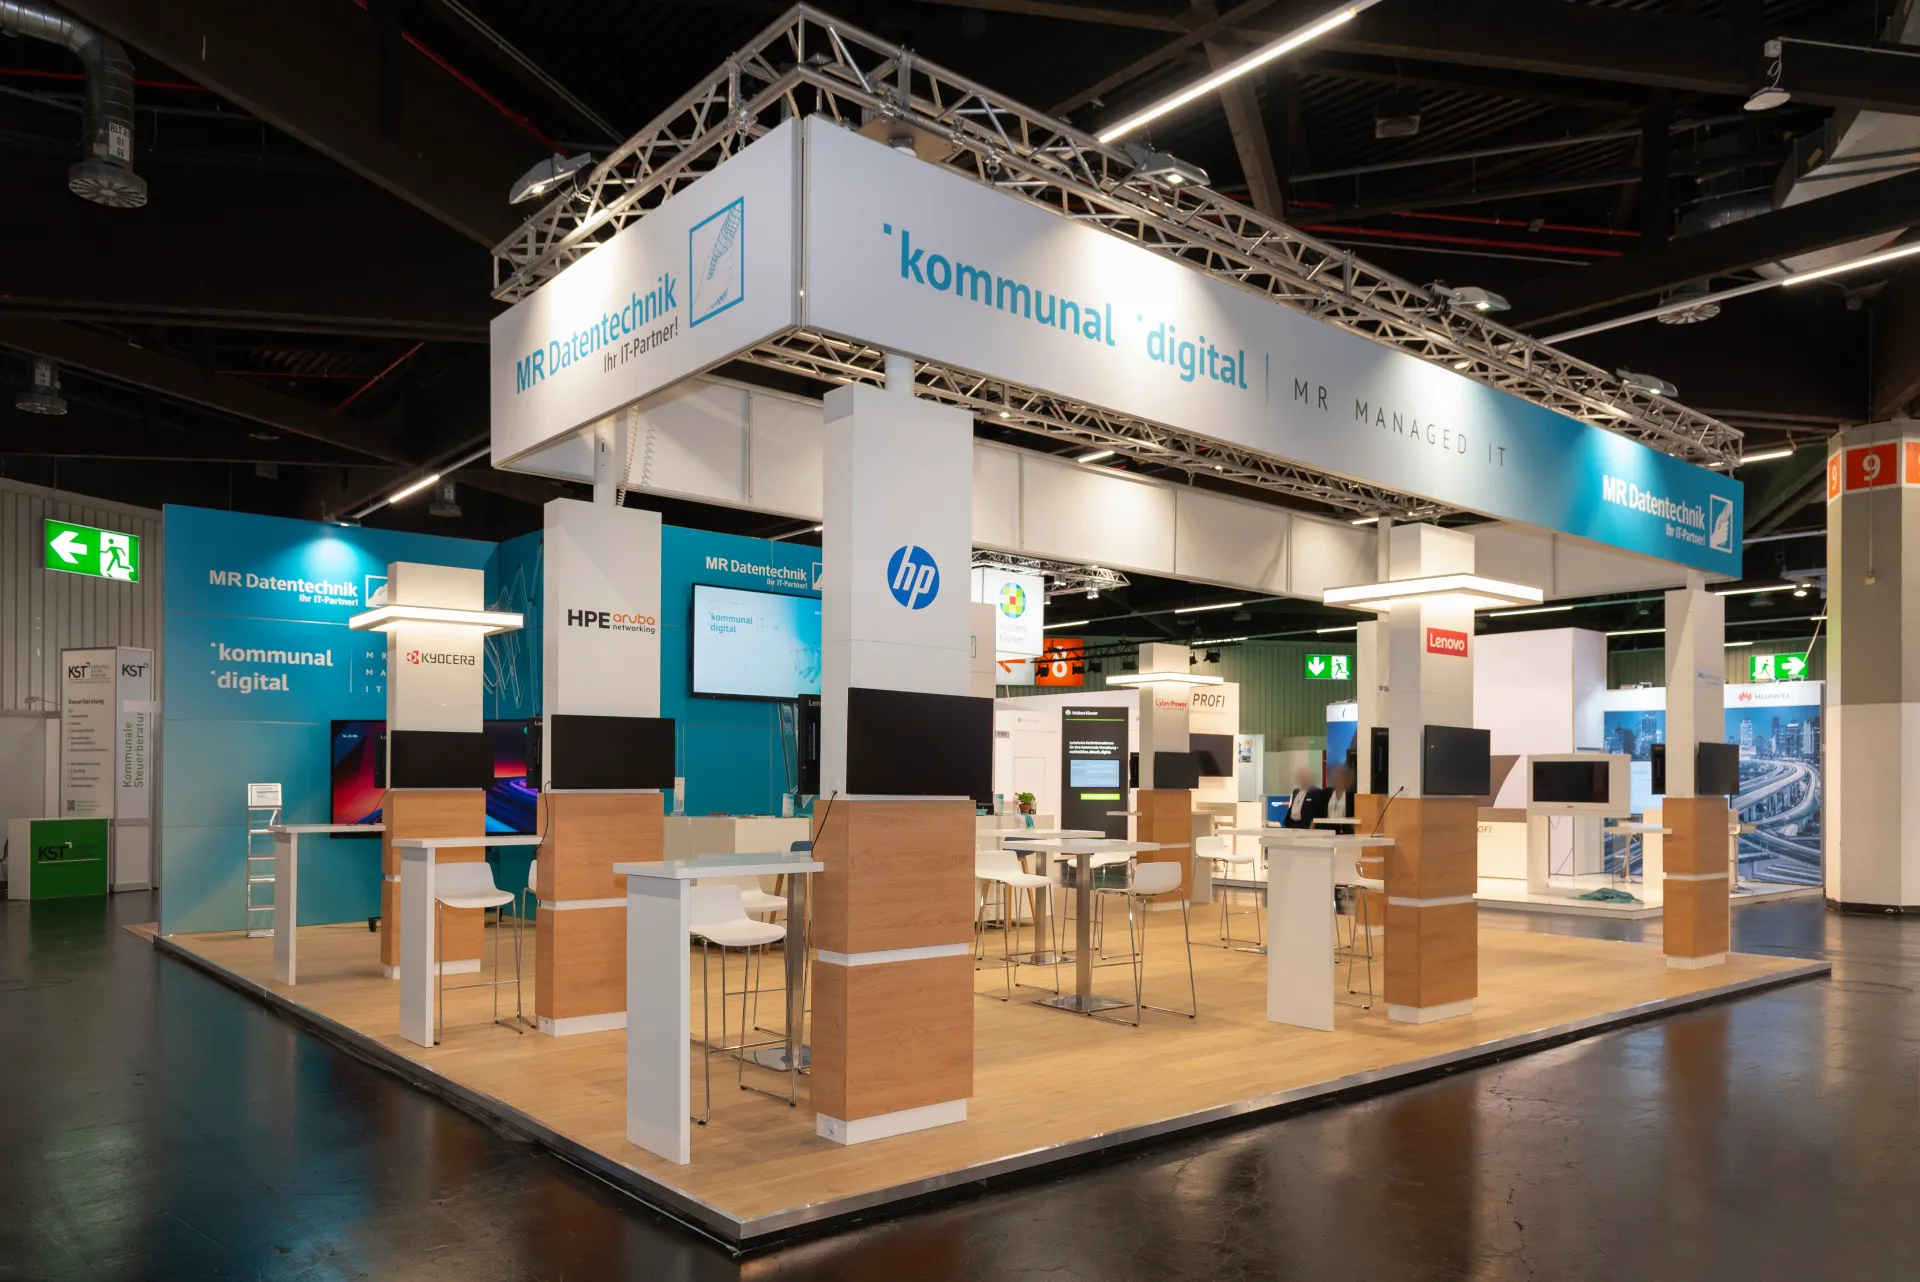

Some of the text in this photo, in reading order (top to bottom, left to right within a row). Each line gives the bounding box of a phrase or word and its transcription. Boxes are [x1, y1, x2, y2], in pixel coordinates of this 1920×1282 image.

[901, 229, 1248, 390] kommunal digital
[516, 272, 678, 395] MR Datentechnik
[603, 316, 679, 374] Ihr IT-Partner!
[1294, 377, 1507, 467] MR MANAGED IT
[1832, 464, 1838, 490] 9
[1862, 453, 1881, 481] 9
[1603, 474, 1706, 530] MR Datentechnik
[1666, 523, 1706, 547] Ihr IT-Partner!
[705, 556, 808, 581] MR Datentechnik
[892, 545, 936, 609] hp
[209, 570, 358, 598] MR Datentechnik
[766, 578, 808, 590] Ihr IT-Partner!
[299, 594, 358, 607] Ihr IT-Partner!
[568, 608, 656, 629] HPE aruba
[612, 624, 656, 634] networking
[710, 612, 753, 624] kommunal
[710, 623, 736, 634] digital
[1430, 632, 1465, 651] Lenovo
[218, 643, 334, 667] kommunal
[421, 652, 476, 666] KYOCERA
[1052, 646, 1068, 678] 8
[68, 665, 88, 678] KST
[122, 664, 146, 678] KST
[217, 672, 290, 694] digital
[1192, 693, 1226, 708] PROFI
[122, 722, 133, 788] Kommunale
[38, 846, 69, 860] KST
